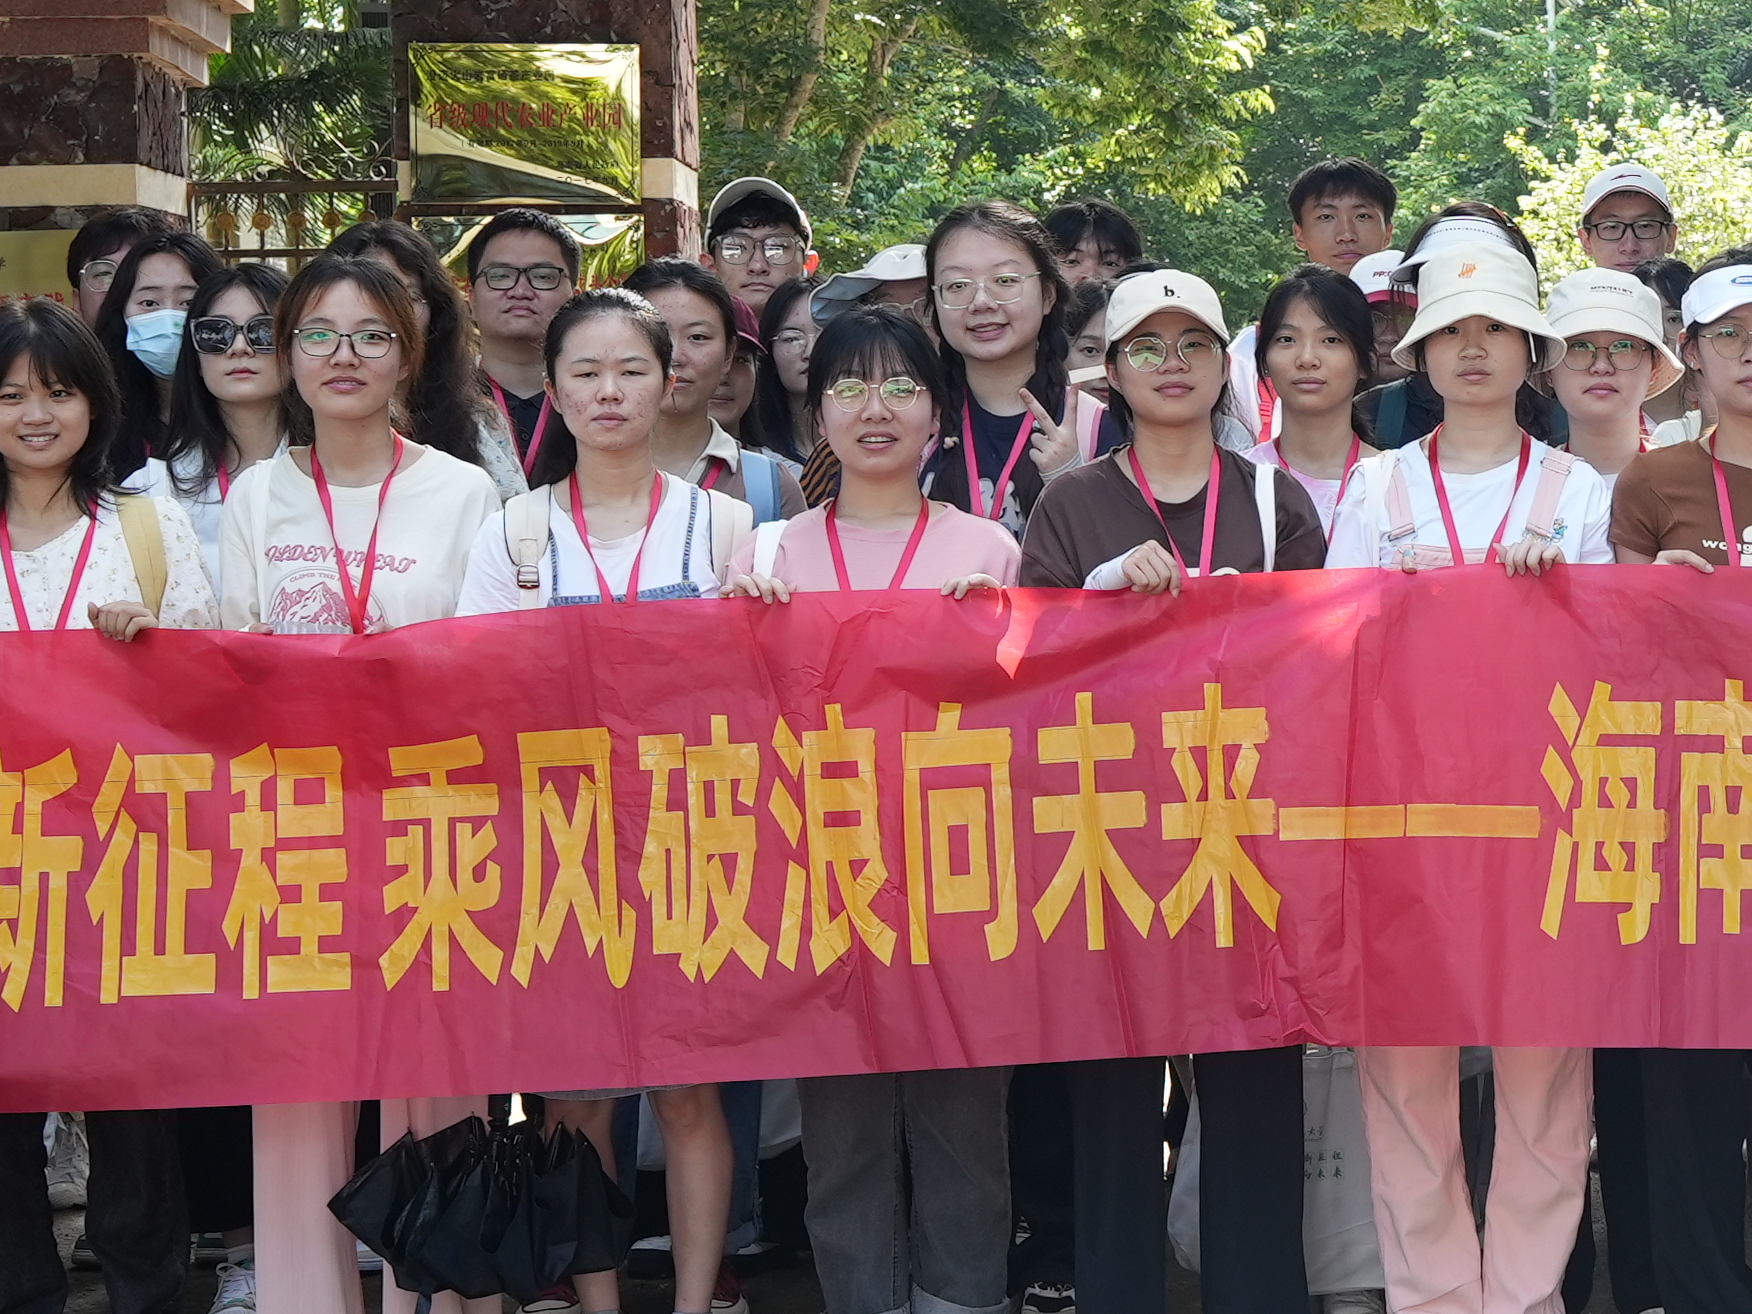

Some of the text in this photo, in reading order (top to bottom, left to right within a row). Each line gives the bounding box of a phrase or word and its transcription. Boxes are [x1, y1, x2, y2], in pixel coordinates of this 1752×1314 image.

[427, 101, 624, 131] 省级现代农业产业园
